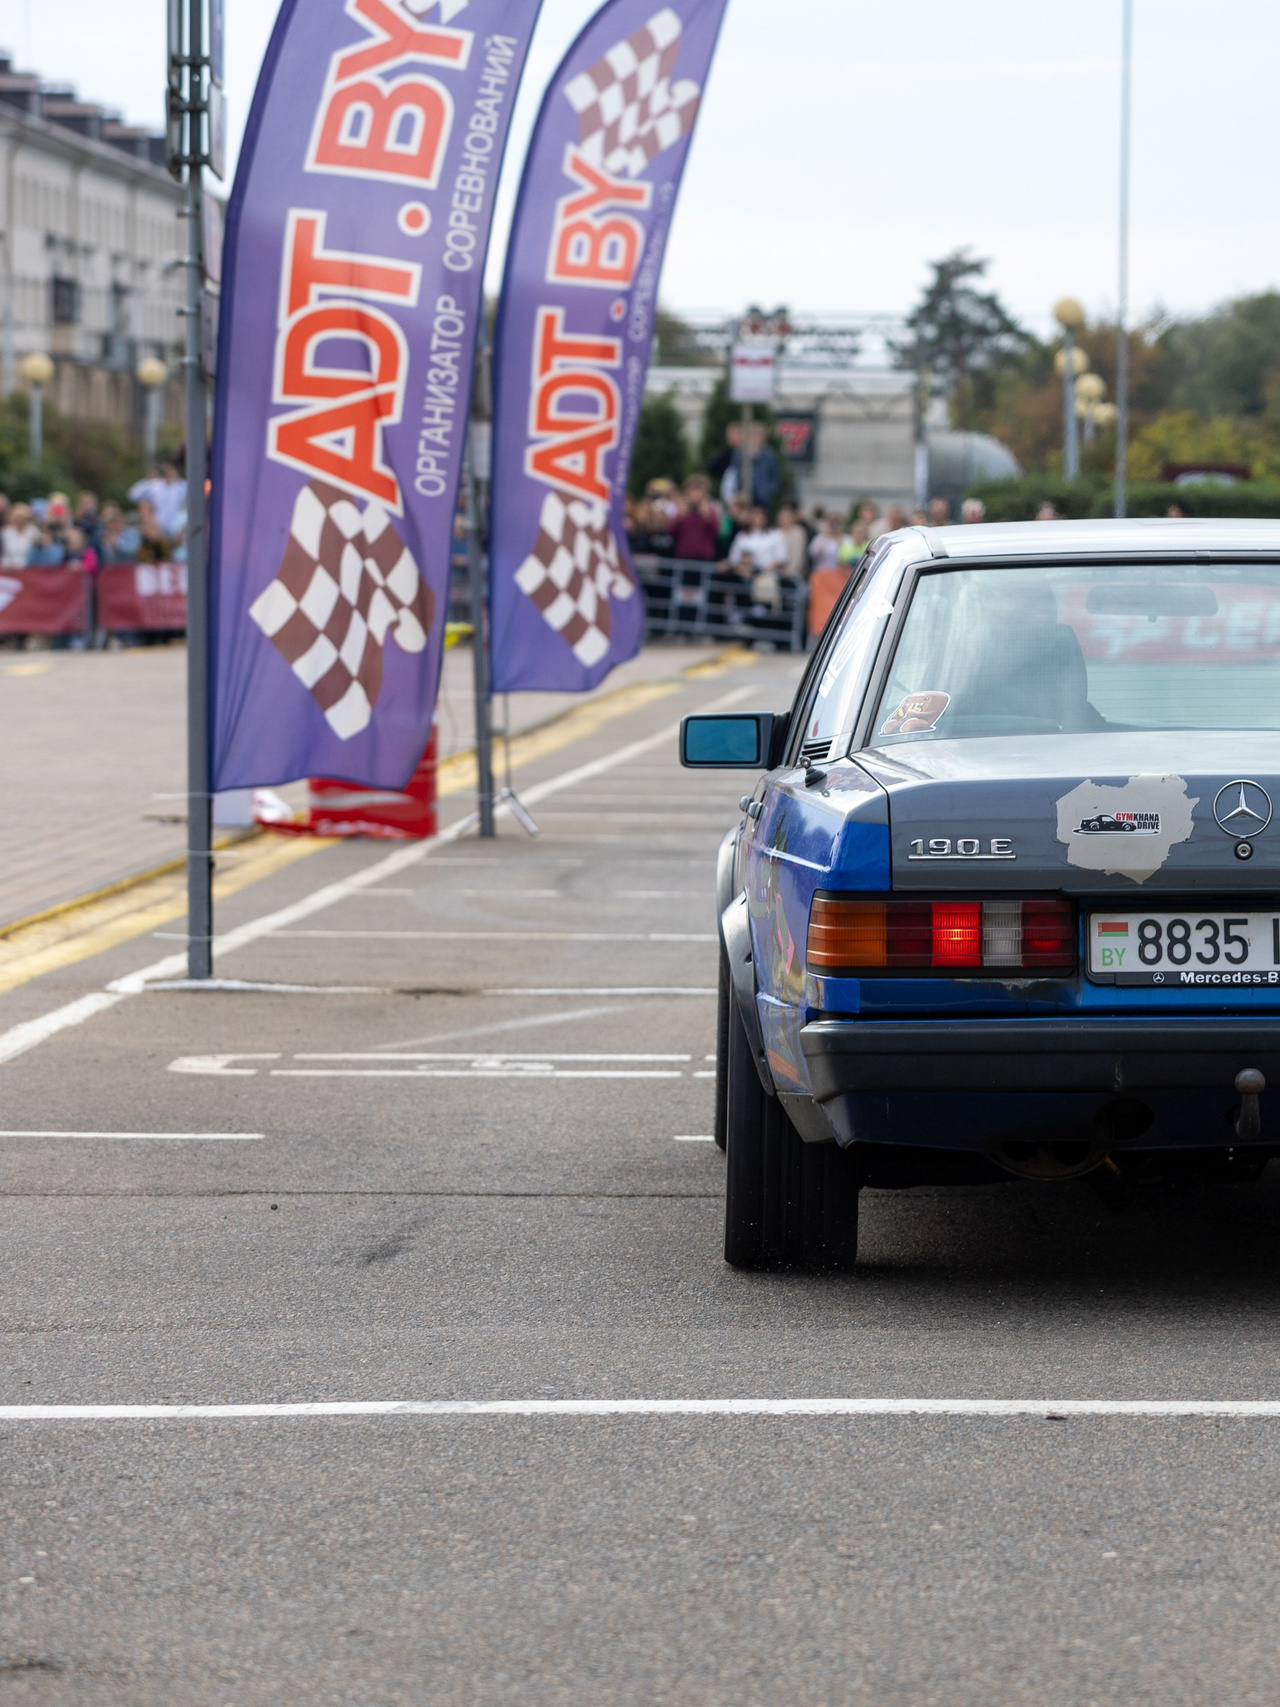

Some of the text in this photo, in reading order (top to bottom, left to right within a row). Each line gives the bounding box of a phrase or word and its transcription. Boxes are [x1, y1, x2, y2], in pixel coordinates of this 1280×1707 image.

[266, 0, 476, 517] ADT.BY
[414, 33, 519, 497] ОРГАНИЗАТОР СОРЕВНОВАНИЙ
[524, 140, 653, 506] ADT.BY
[1115, 812, 1160, 822] GYMKHANA
[1137, 821, 1160, 830] DRIVE
[910, 838, 1013, 855] 190 E
[1101, 947, 1127, 966] BY
[1137, 918, 1249, 965] 8835
